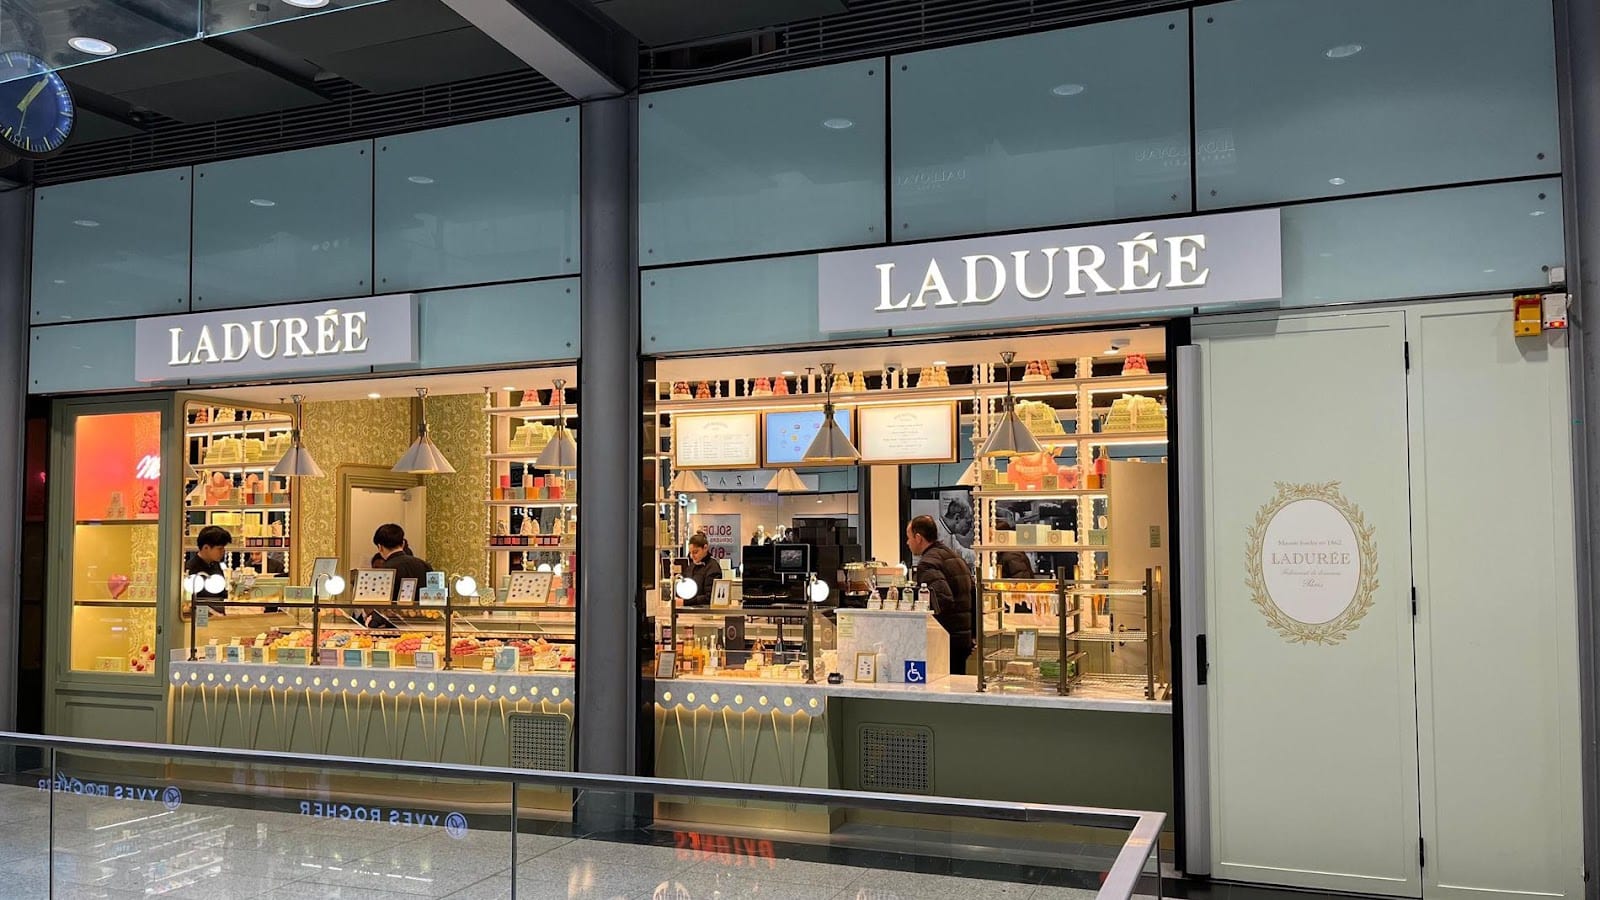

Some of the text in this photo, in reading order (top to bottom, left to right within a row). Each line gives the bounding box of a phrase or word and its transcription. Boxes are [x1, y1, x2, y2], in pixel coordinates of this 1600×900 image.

[874, 232, 1210, 313] LADURÉE
[168, 308, 368, 366] LADURÉE
[1272, 552, 1350, 565] LADURÉE
